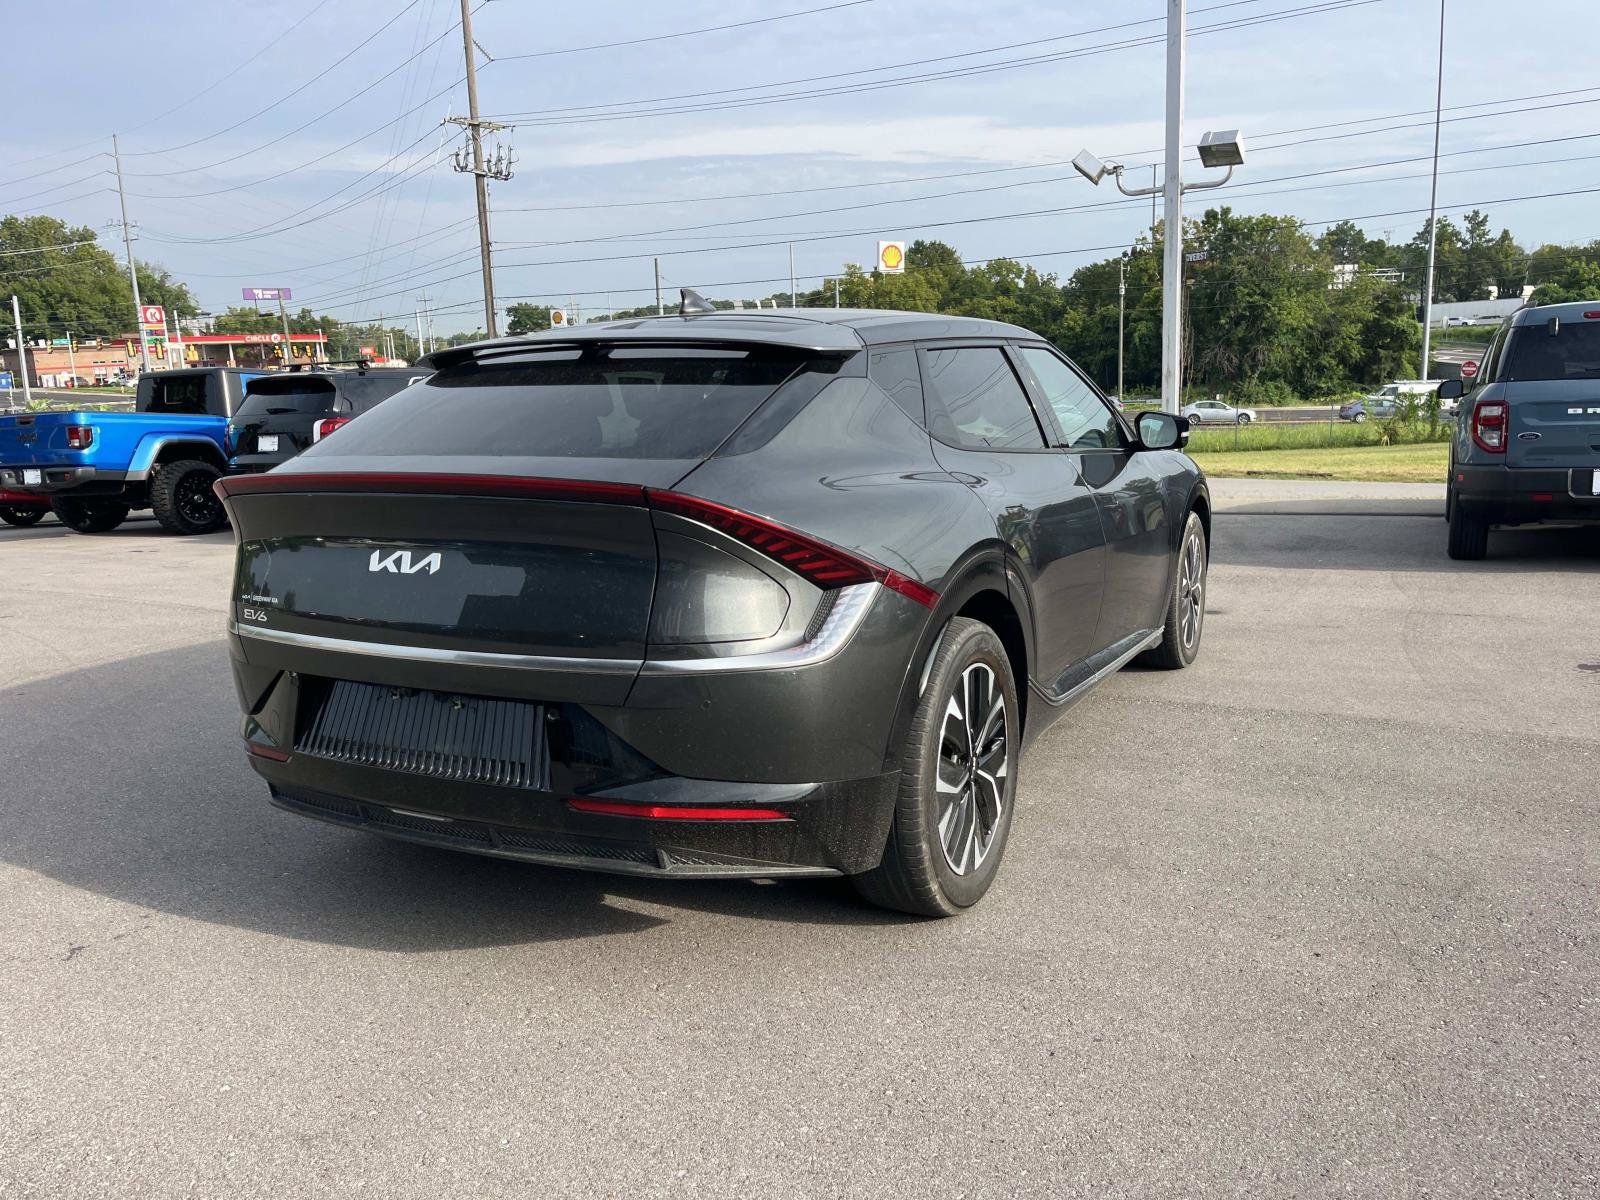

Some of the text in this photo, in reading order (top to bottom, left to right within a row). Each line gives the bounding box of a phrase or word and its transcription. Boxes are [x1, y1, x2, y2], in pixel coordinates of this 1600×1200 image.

[245, 335, 271, 343] CIRCLE
[368, 549, 442, 575] KIA
[243, 608, 268, 622] EV6
